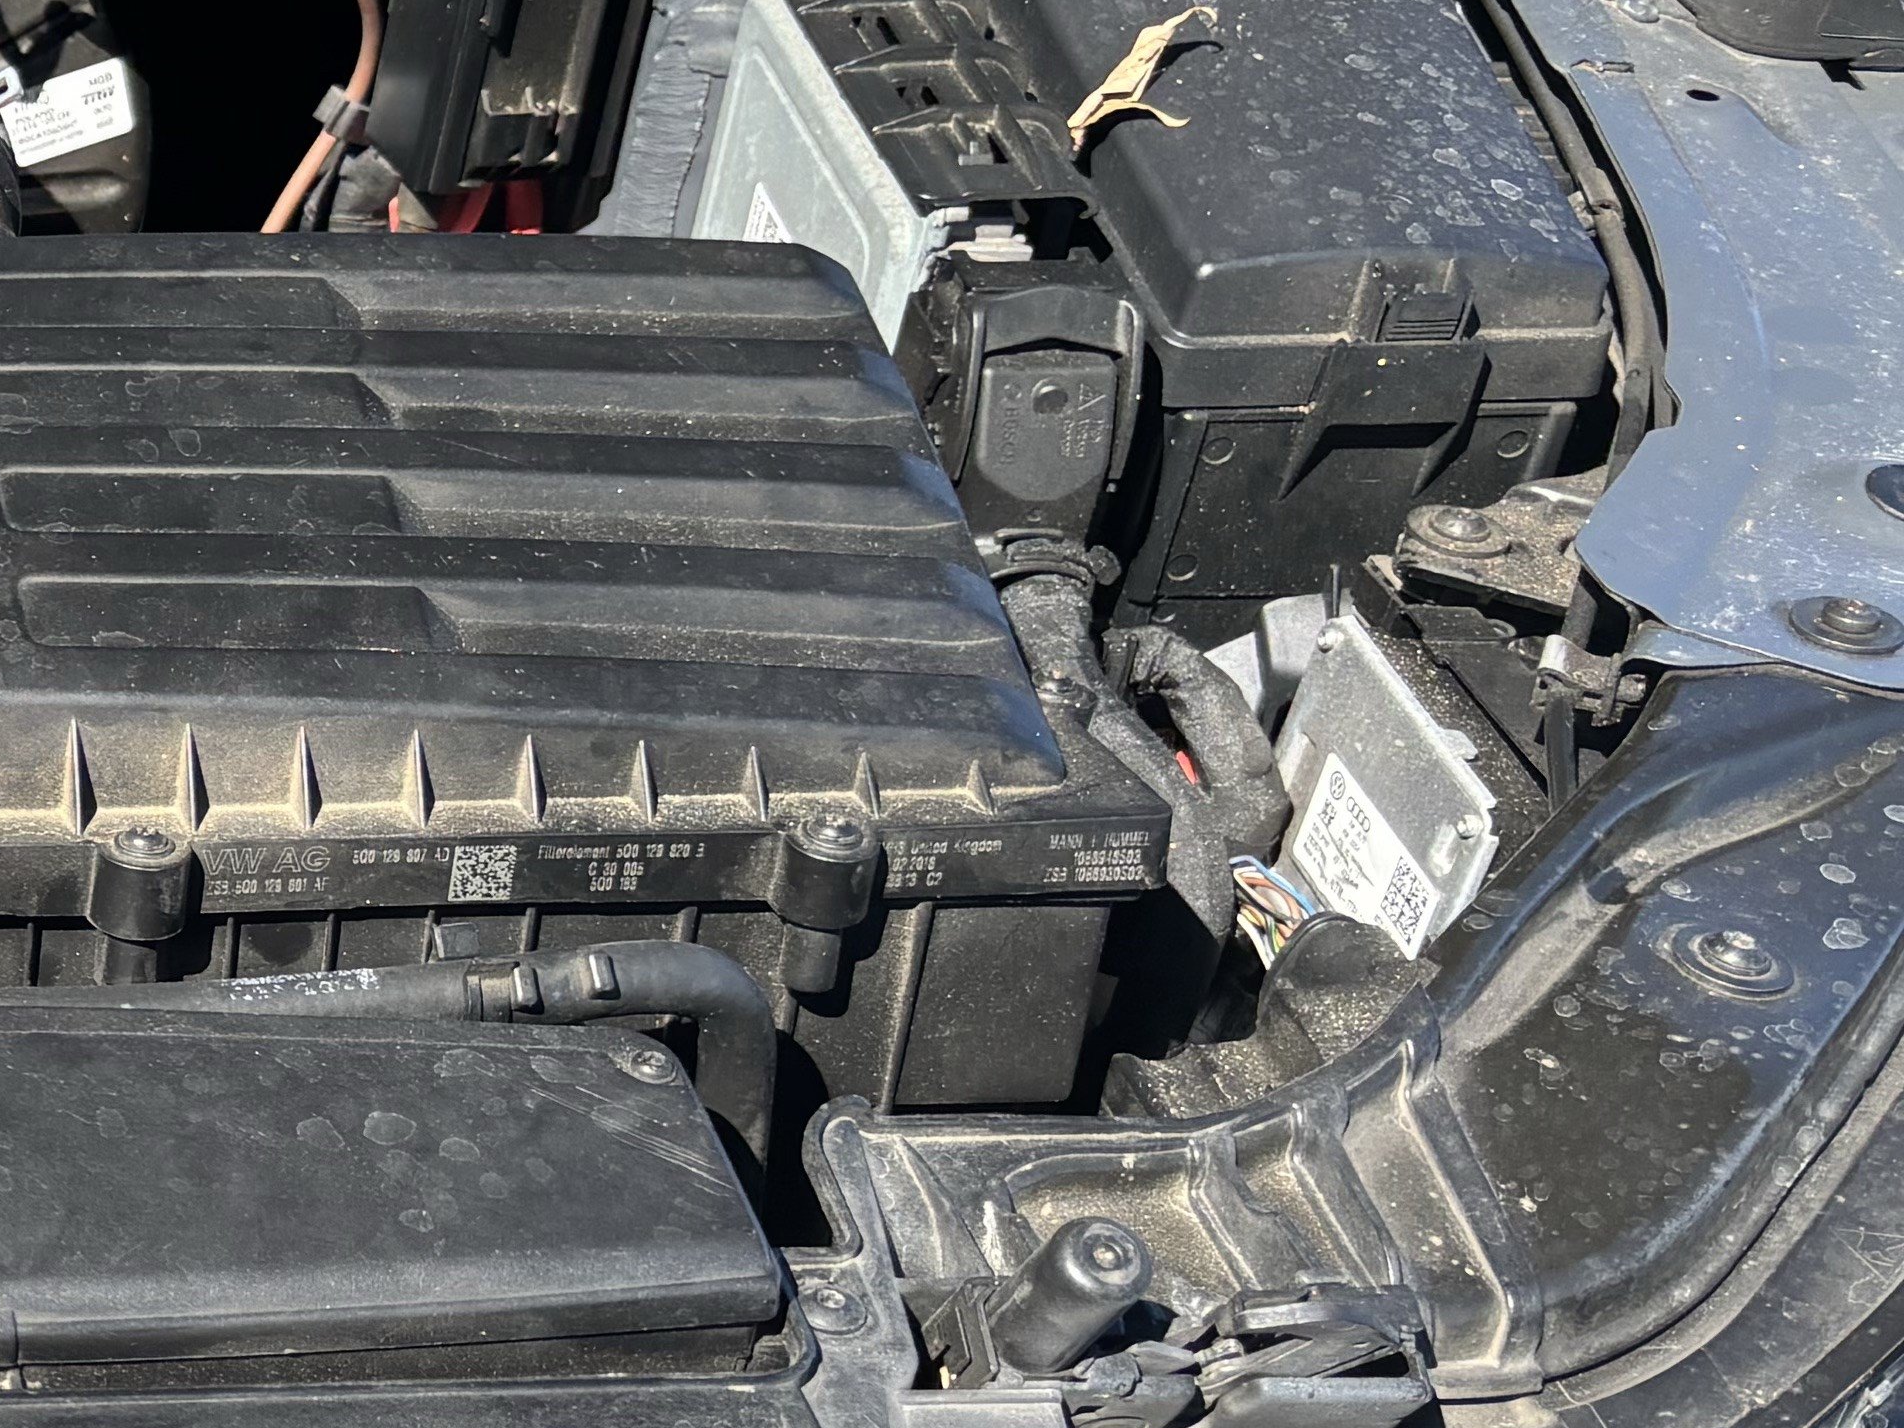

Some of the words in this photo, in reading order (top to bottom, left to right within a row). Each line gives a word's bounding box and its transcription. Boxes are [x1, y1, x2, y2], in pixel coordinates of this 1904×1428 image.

[1049, 834, 1083, 850] MANN
[202, 847, 267, 875] VW
[272, 845, 331, 873] AG
[587, 861, 597, 876] C
